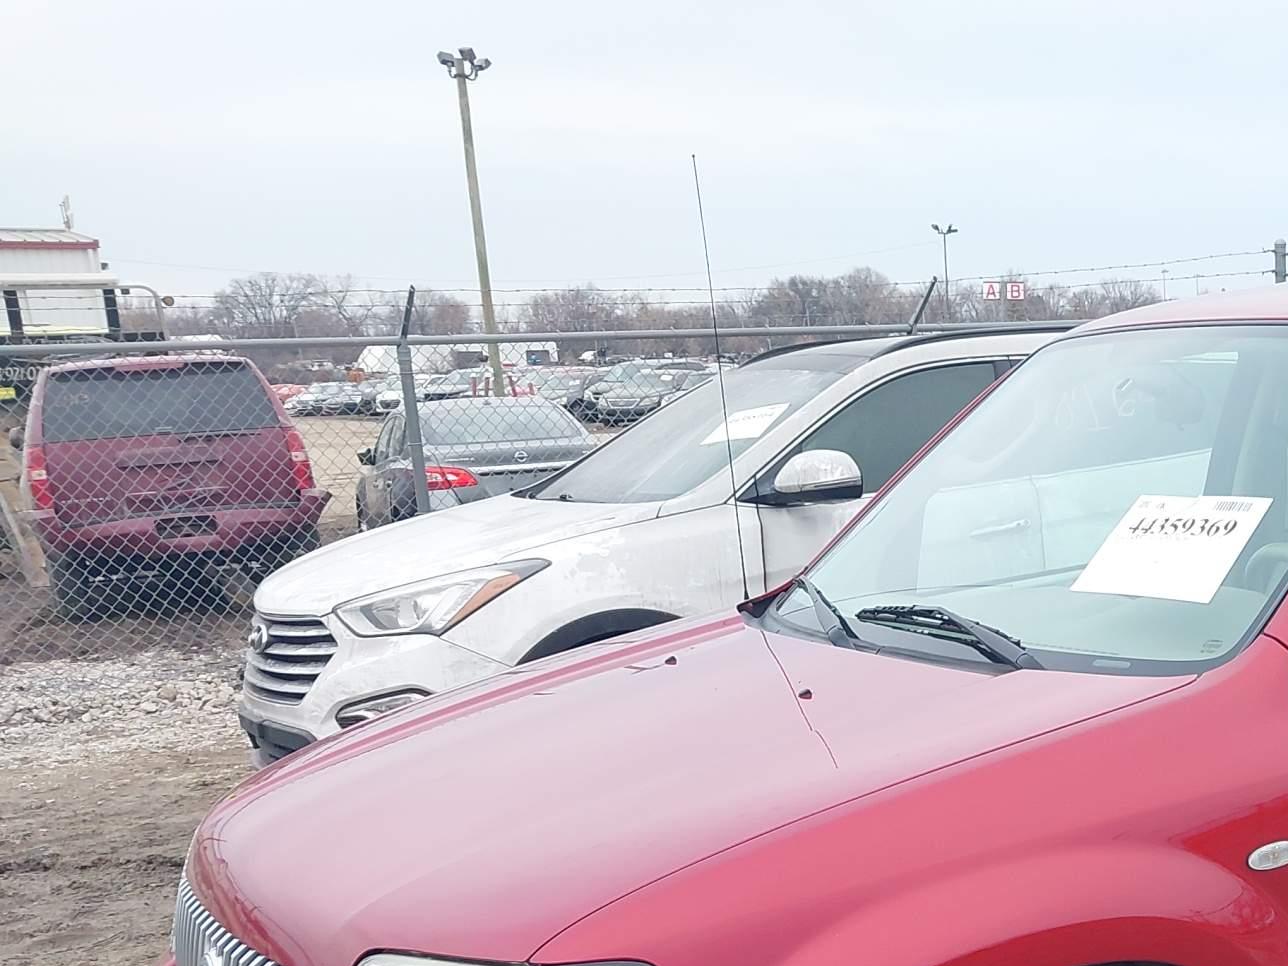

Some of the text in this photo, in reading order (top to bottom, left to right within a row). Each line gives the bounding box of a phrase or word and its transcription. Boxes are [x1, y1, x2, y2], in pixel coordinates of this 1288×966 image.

[985, 284, 997, 299] A
[1010, 284, 1021, 299] B
[1128, 516, 1238, 537] 44359369
